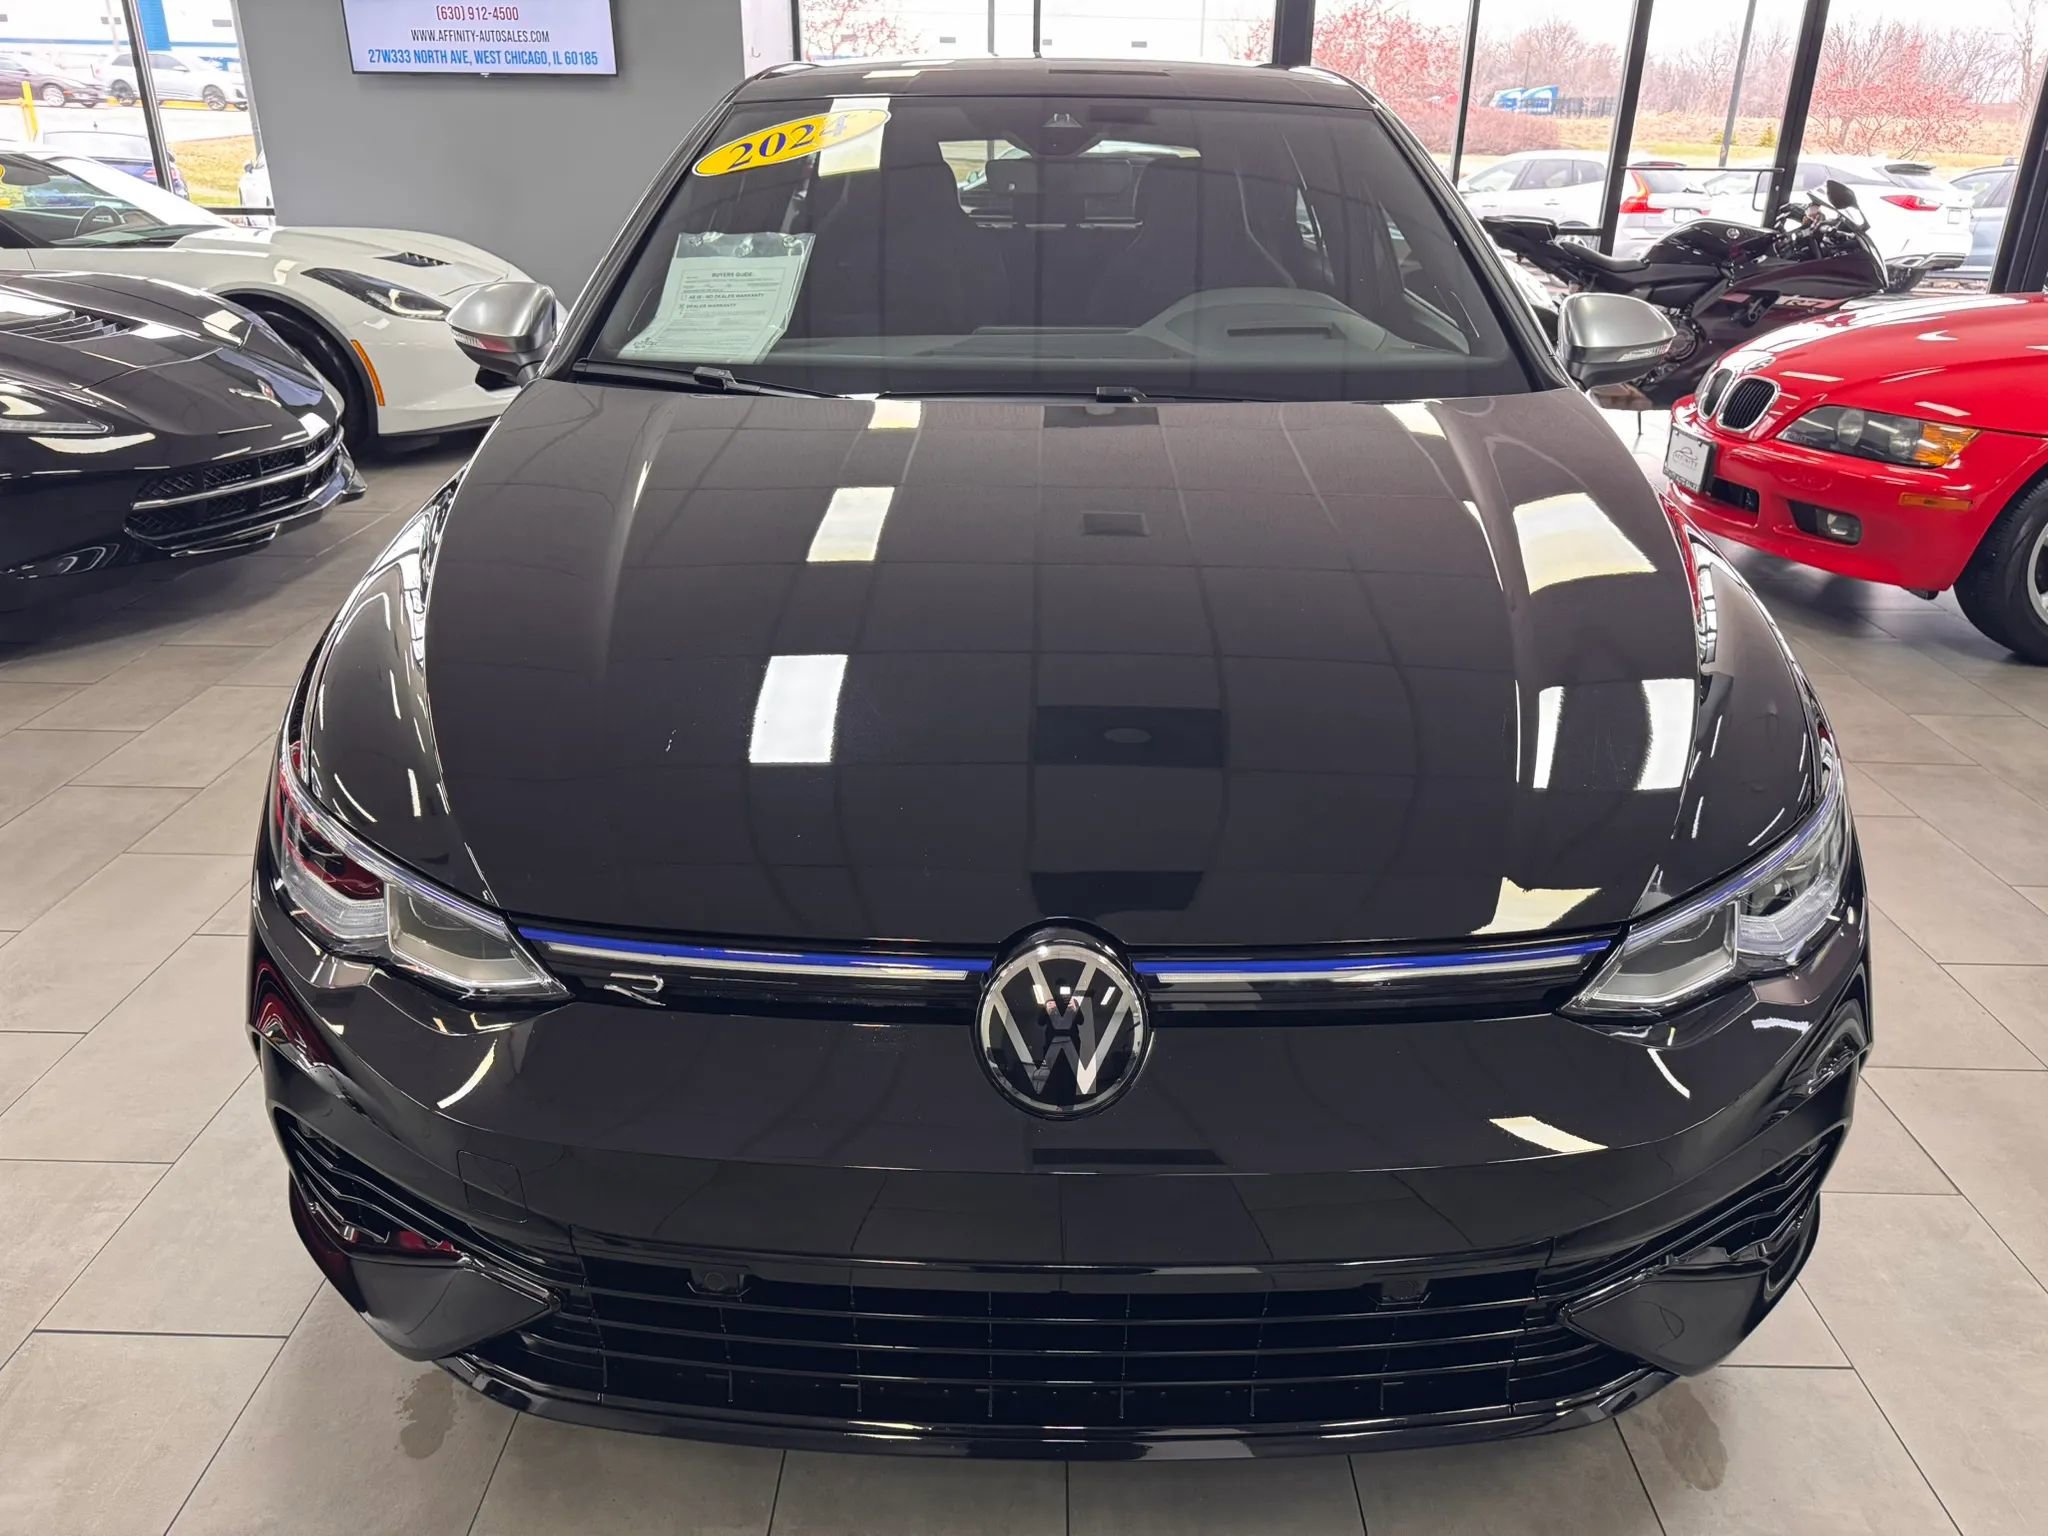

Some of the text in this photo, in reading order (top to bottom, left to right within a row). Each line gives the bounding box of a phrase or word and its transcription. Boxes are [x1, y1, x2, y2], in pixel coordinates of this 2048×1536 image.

[436, 5, 519, 21] (630) 912-4500
[410, 28, 550, 44] WWW.AFFINITY-AUTOSALES.COM
[368, 49, 598, 67] 27W333 NORTH AVE, WEST CHICAGO, IL 60185
[727, 114, 850, 170] 2024
[603, 972, 667, 1007] R
